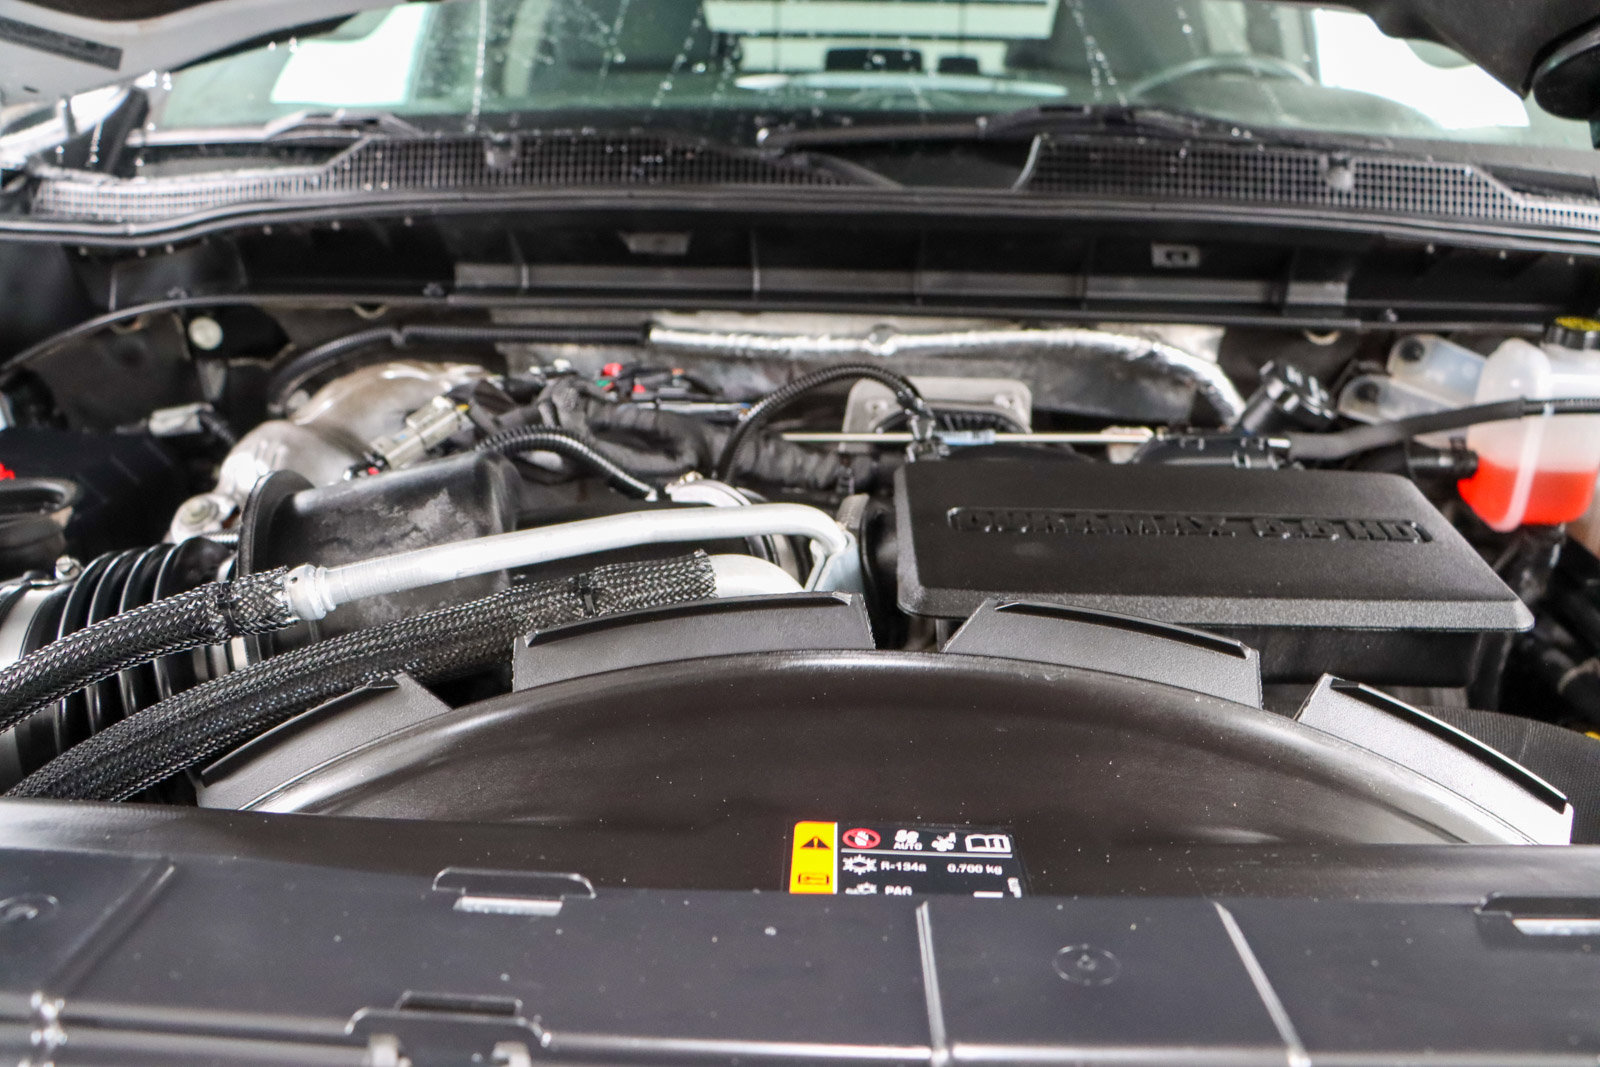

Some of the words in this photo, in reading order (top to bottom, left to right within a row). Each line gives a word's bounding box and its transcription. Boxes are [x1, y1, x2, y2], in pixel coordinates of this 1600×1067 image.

[893, 841, 923, 850] AUTO
[880, 860, 928, 872] R-134a
[946, 863, 984, 874] 0.700
[985, 864, 1003, 876] kg
